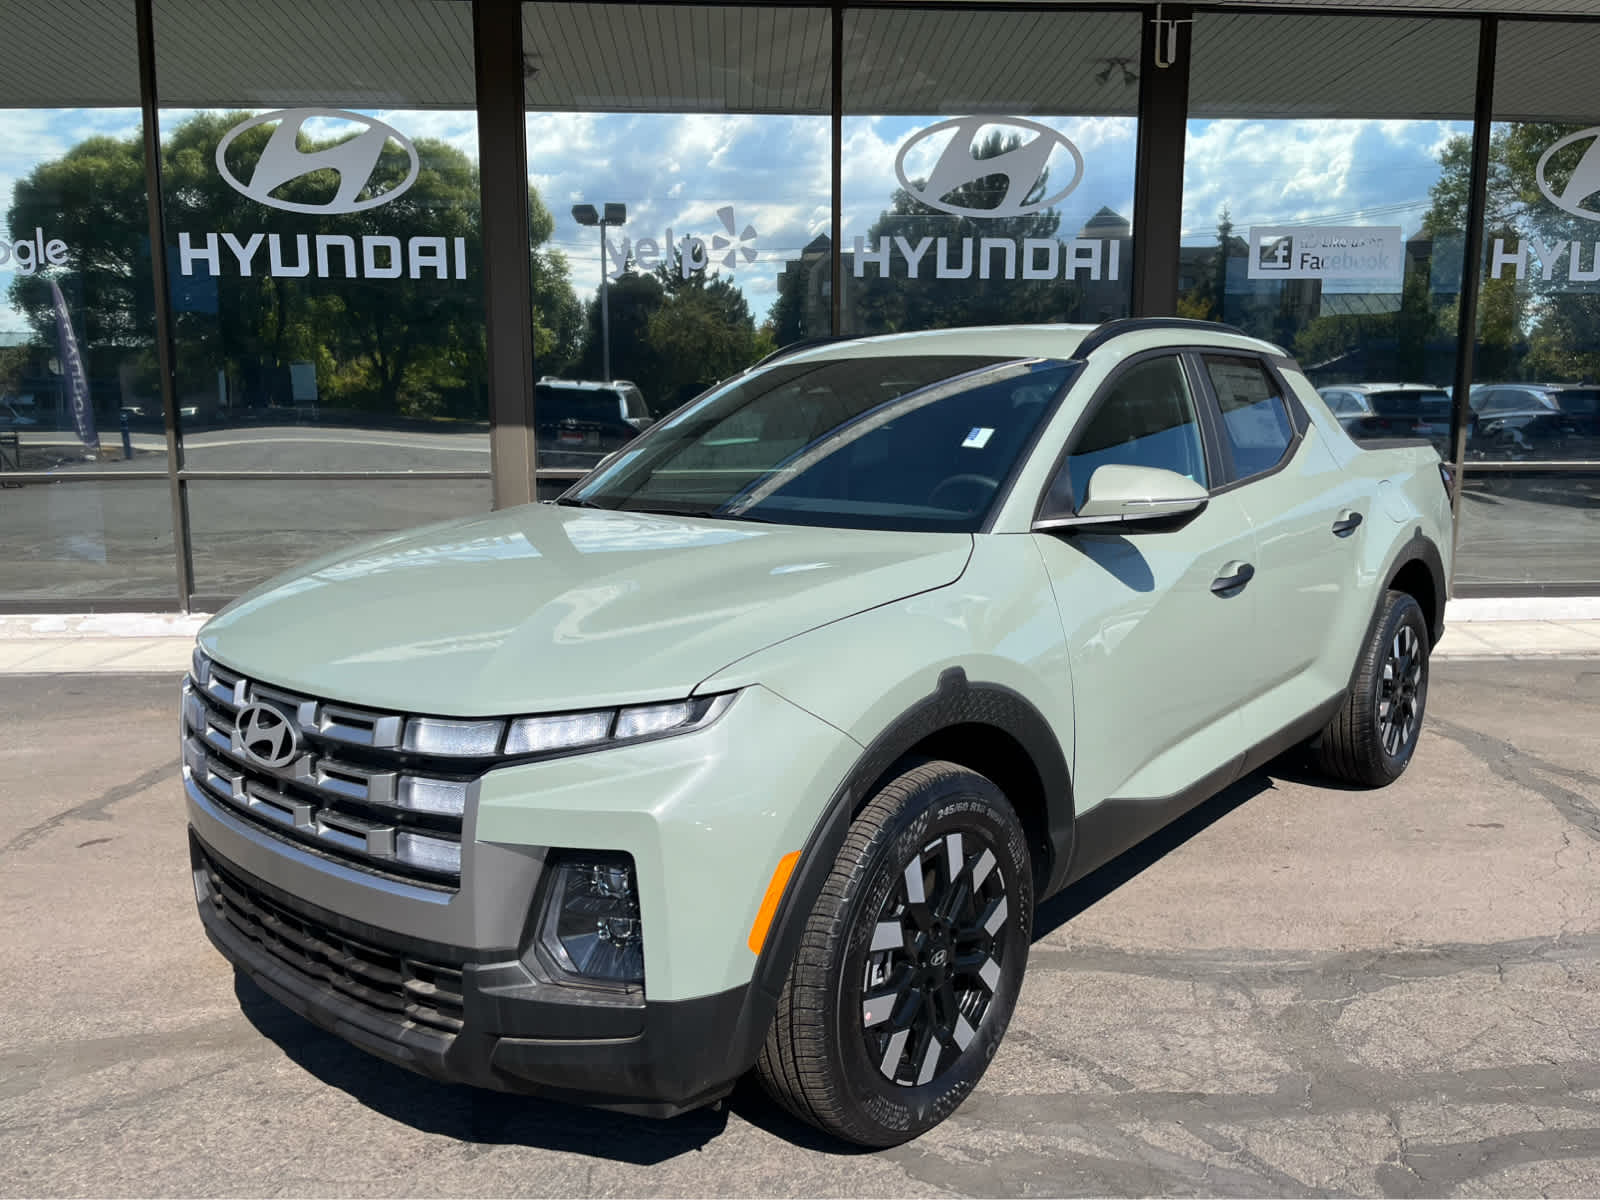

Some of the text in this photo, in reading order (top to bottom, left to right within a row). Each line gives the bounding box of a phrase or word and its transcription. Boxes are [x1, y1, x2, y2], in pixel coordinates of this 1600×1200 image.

[179, 231, 467, 280] HYUNDAI
[605, 227, 708, 280] yelp
[853, 236, 1120, 281] HYUNDAI
[1300, 249, 1391, 270] Facebook
